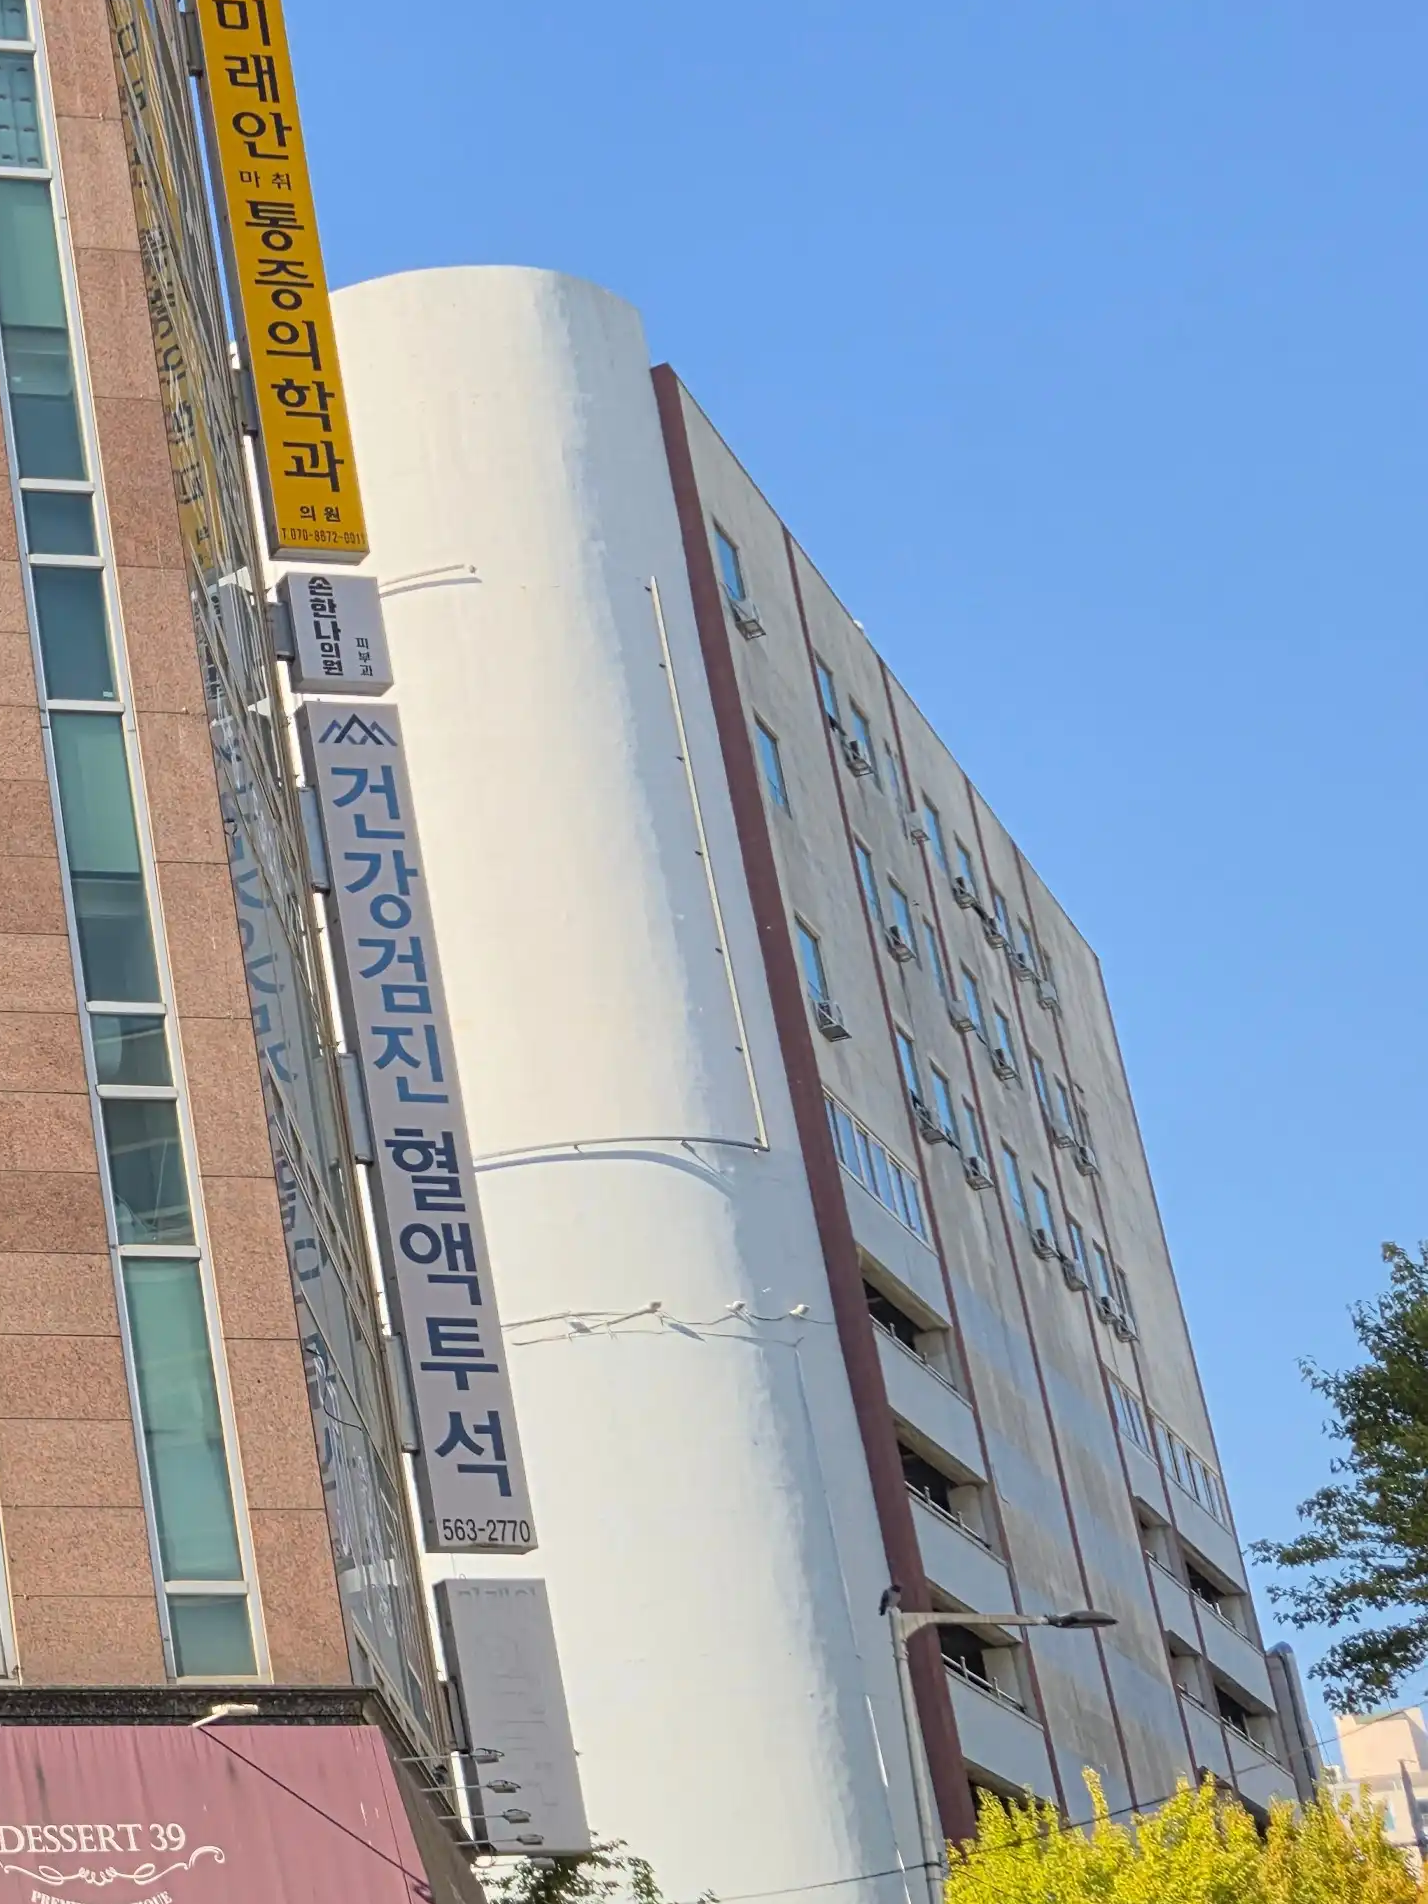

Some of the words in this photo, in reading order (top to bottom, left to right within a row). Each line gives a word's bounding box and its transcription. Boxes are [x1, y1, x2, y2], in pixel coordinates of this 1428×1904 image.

[238, 170, 293, 193] 마취
[244, 198, 345, 494] 통증의학과
[298, 504, 343, 524] 의원
[307, 575, 344, 677] 손한나의원
[353, 636, 374, 678] 피부과
[330, 764, 451, 1106] 건강검진
[384, 1129, 512, 1498] 혈액투석
[442, 1517, 532, 1545] 563-2770
[148, 1821, 187, 1854] 39
